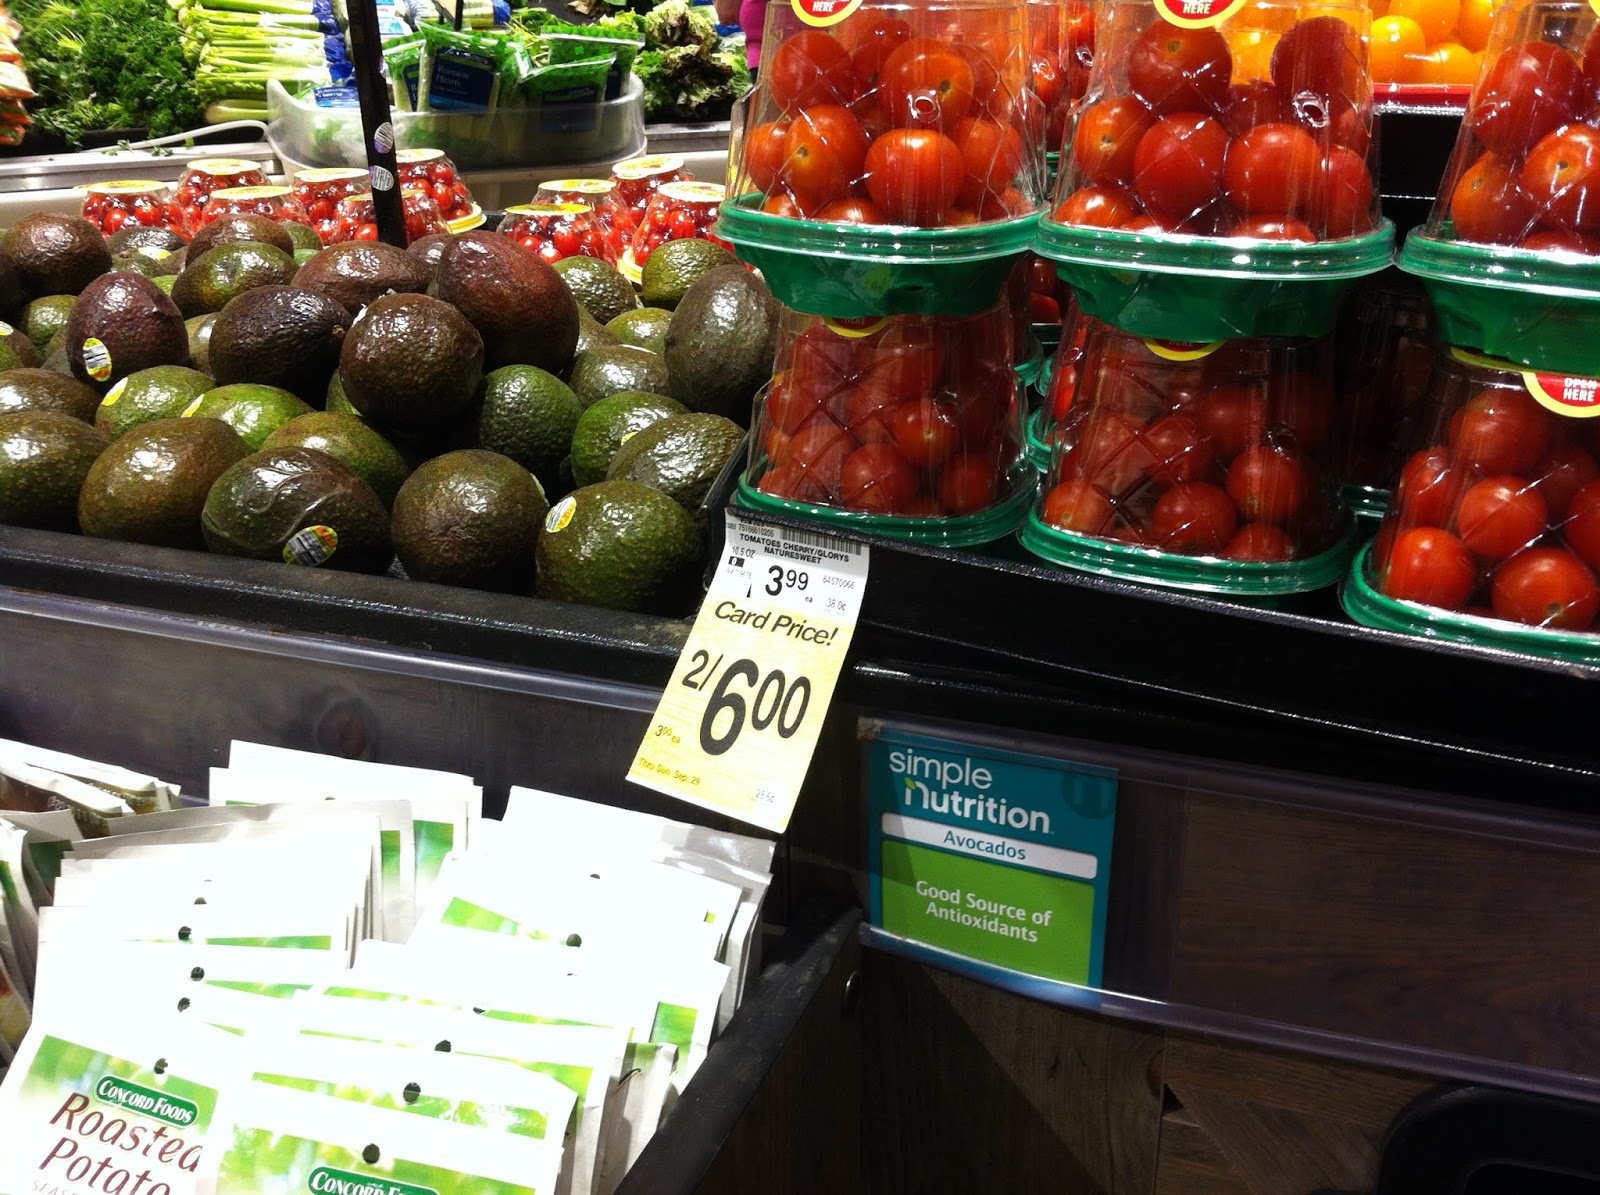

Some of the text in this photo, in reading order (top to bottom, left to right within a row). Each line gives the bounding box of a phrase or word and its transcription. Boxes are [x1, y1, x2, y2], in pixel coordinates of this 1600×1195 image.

[812, 1, 836, 12] HERE
[1182, 3, 1212, 14] HERE
[436, 73, 461, 86] Hearts
[437, 64, 469, 79] Romaine
[1563, 377, 1598, 390] OPEN
[1563, 388, 1596, 402] HERE
[740, 533, 850, 562] TOMATOES CHERRY/GLORYS
[745, 548, 756, 559] OZ
[764, 546, 822, 565] NATURESWEET
[715, 601, 839, 646] Card Price!
[638, 757, 655, 770] Thru
[690, 775, 701, 786] 29
[888, 748, 993, 790] simple
[943, 830, 1026, 860] Avocados
[915, 880, 1053, 927] Good Source of
[925, 902, 1038, 943] Antioxidants
[98, 1080, 195, 1123] CONCORD FOODS
